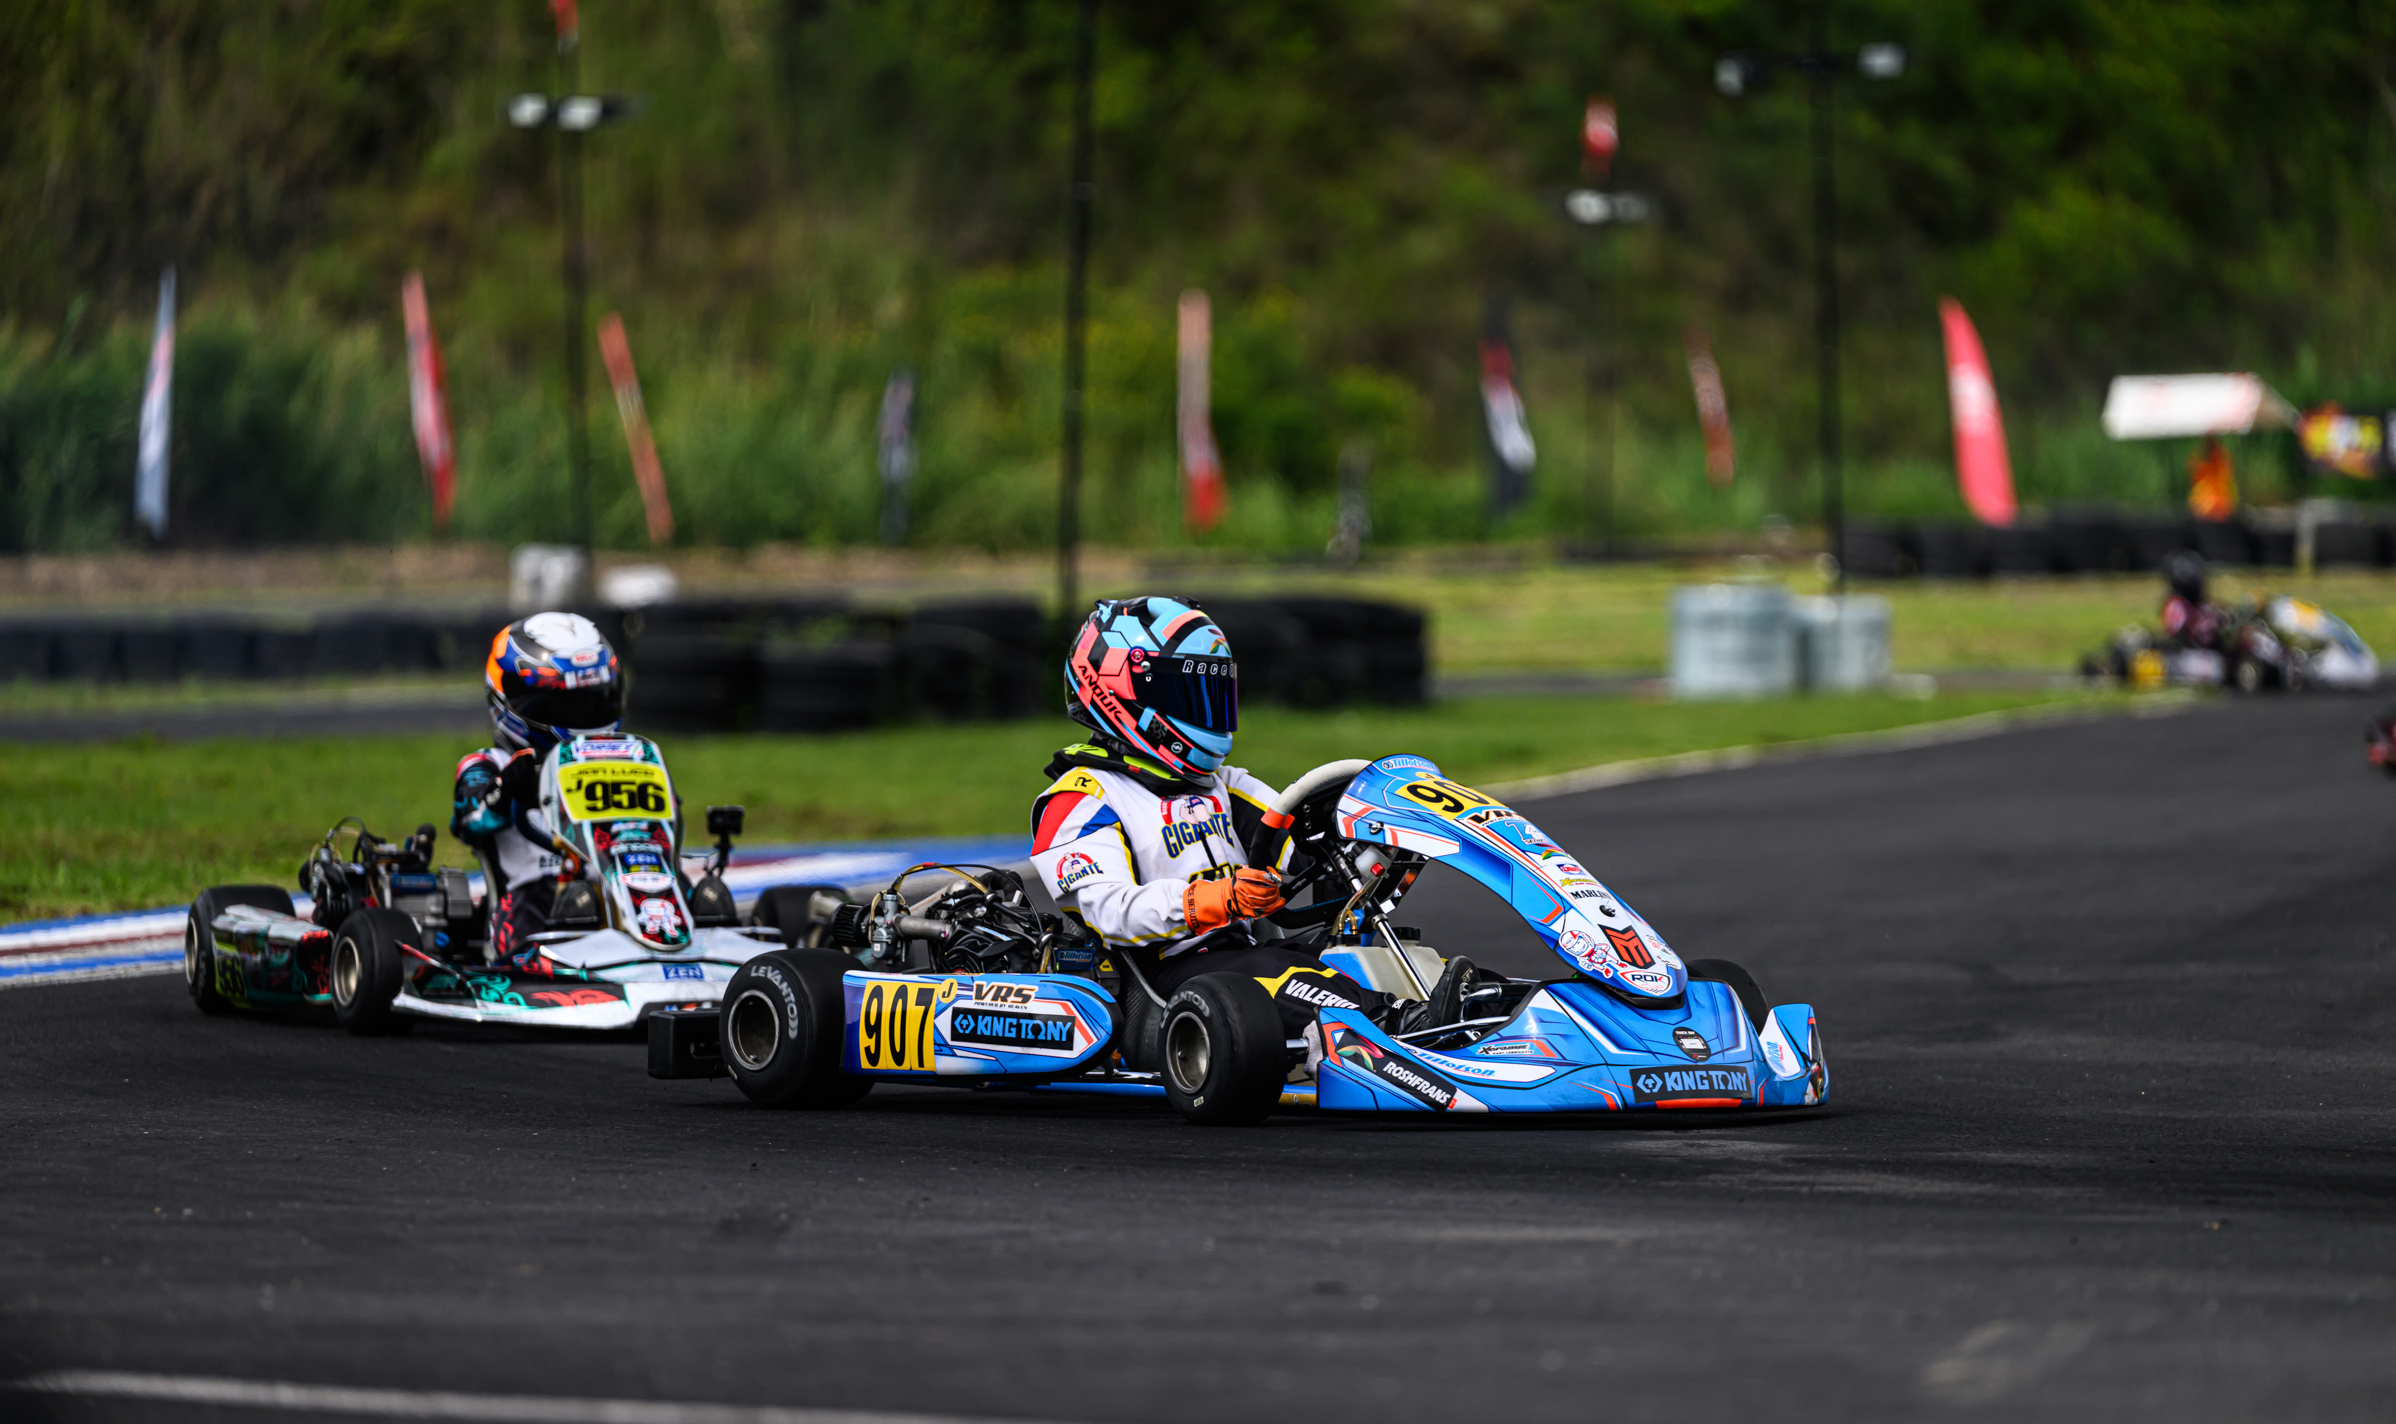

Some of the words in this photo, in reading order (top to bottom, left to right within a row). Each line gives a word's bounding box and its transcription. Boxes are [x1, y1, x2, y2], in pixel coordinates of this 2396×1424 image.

[1182, 659, 1236, 678] Race
[1078, 665, 1123, 723] ANOUK
[585, 781, 665, 812] 956
[1467, 809, 1523, 824] VR
[1056, 861, 1105, 894] GIGANTE
[941, 982, 954, 998] J
[1631, 974, 1663, 982] ROK
[751, 965, 798, 1019] LEVANTO
[974, 983, 1037, 1004] VRS
[864, 984, 935, 1068] 907
[977, 1016, 1016, 1037] KING
[1019, 1019, 1073, 1042] TONY
[1418, 1052, 1496, 1076] Tillotson
[1382, 1061, 1451, 1105] ROSHFRANS
[1664, 1070, 1710, 1091] KING
[1711, 1073, 1748, 1092] TONY
